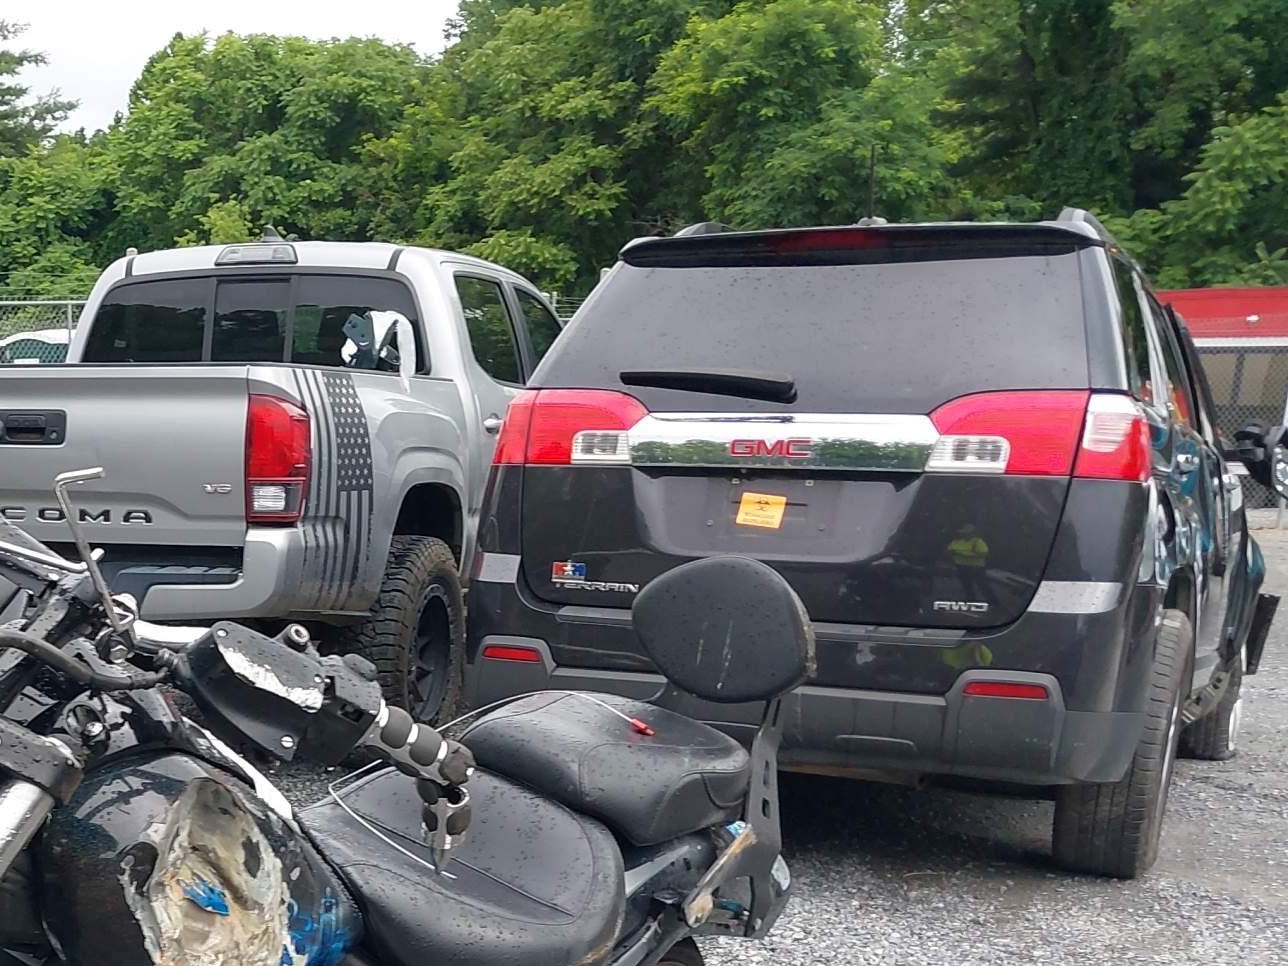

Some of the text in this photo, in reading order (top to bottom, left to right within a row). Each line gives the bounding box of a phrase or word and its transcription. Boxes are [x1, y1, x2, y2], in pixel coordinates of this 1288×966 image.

[730, 438, 812, 457] GMC
[201, 482, 232, 494] V6
[0, 506, 154, 526] COMA
[551, 578, 640, 593] TERRAIN
[933, 600, 989, 612] AWD
